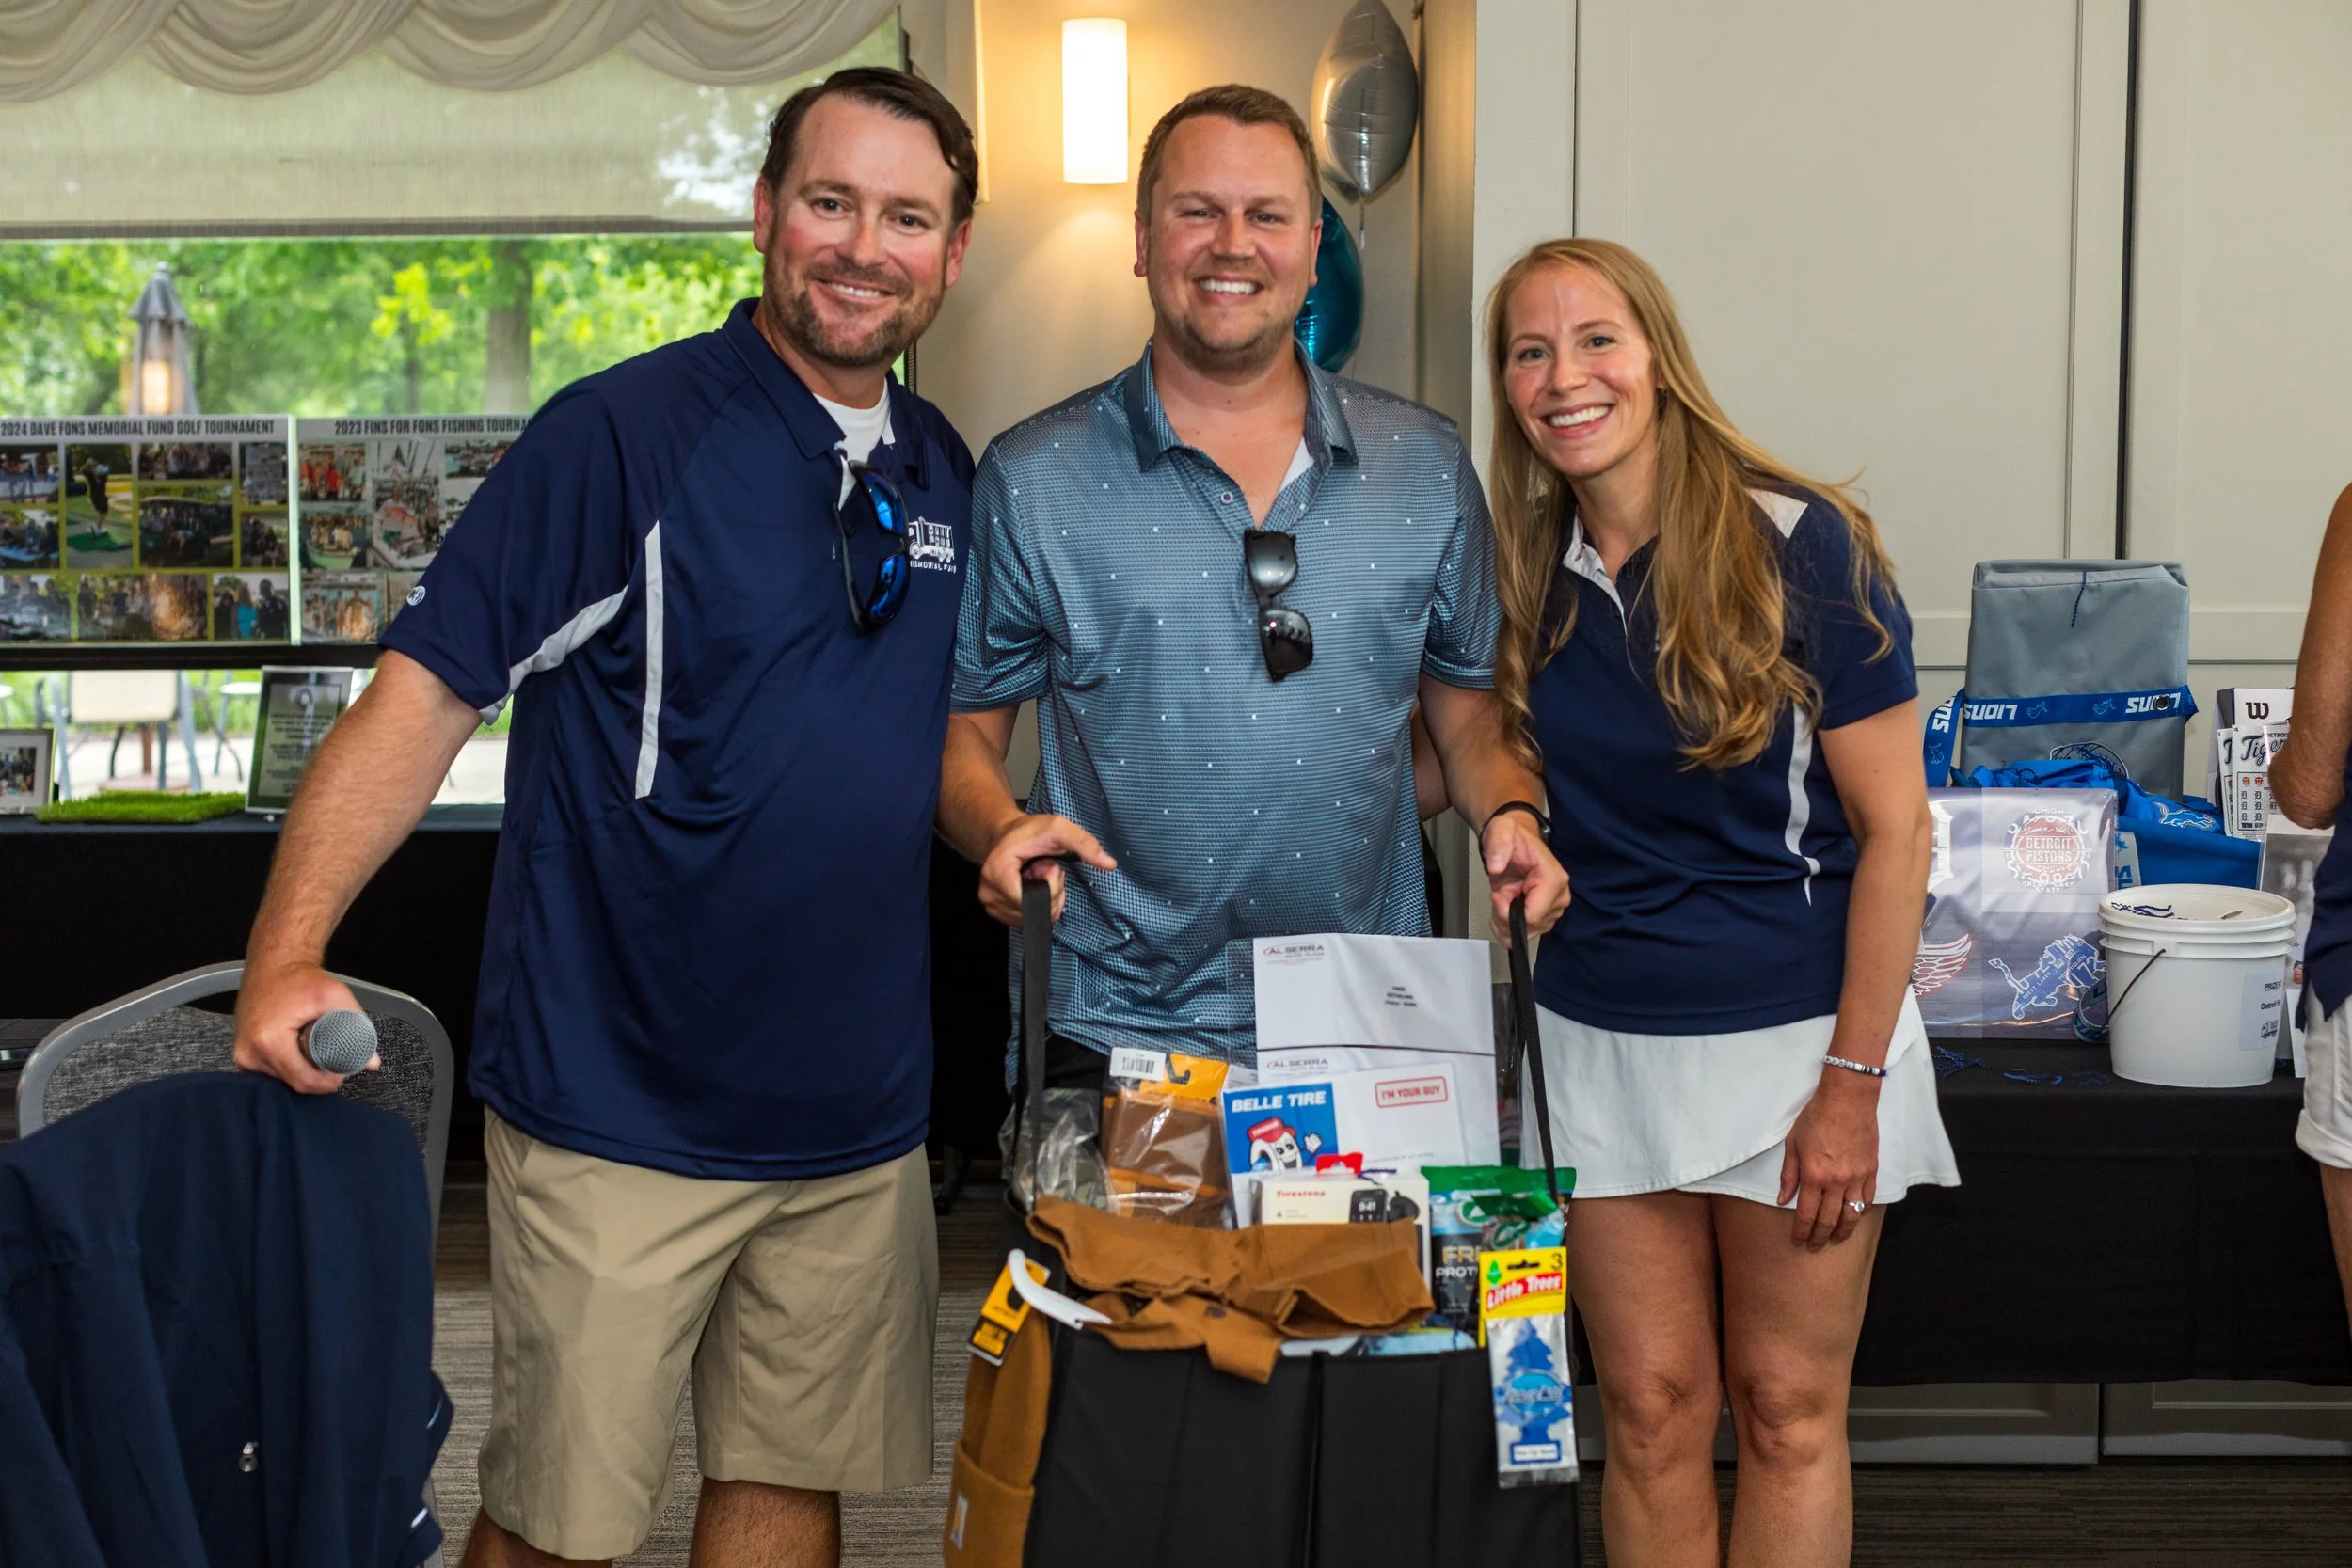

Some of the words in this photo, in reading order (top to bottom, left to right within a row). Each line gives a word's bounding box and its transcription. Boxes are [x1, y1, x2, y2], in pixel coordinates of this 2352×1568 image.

[1, 420, 27, 436] 2024
[30, 420, 56, 435] DAVE
[59, 420, 86, 435] FONS
[88, 420, 144, 435] MEMORIAL
[147, 420, 173, 434] FUND
[177, 420, 201, 434] GOLF
[205, 419, 275, 434] TOURNAMENT
[335, 420, 361, 435] 2023
[364, 420, 388, 434] FINS
[390, 420, 410, 434] FOR
[413, 419, 439, 434] FONS
[442, 419, 485, 434] FISHING
[487, 418, 533, 433] TOURNA
[2026, 837, 2072, 850] DETROIT
[2026, 850, 2072, 863] PISTONS
[1398, 1087, 1421, 1098] YOUR
[1232, 1095, 1283, 1113] BELLE
[1287, 1090, 1327, 1107] TIRE
[1486, 1280, 1524, 1311] Little
[1525, 1275, 1562, 1294] Trees
